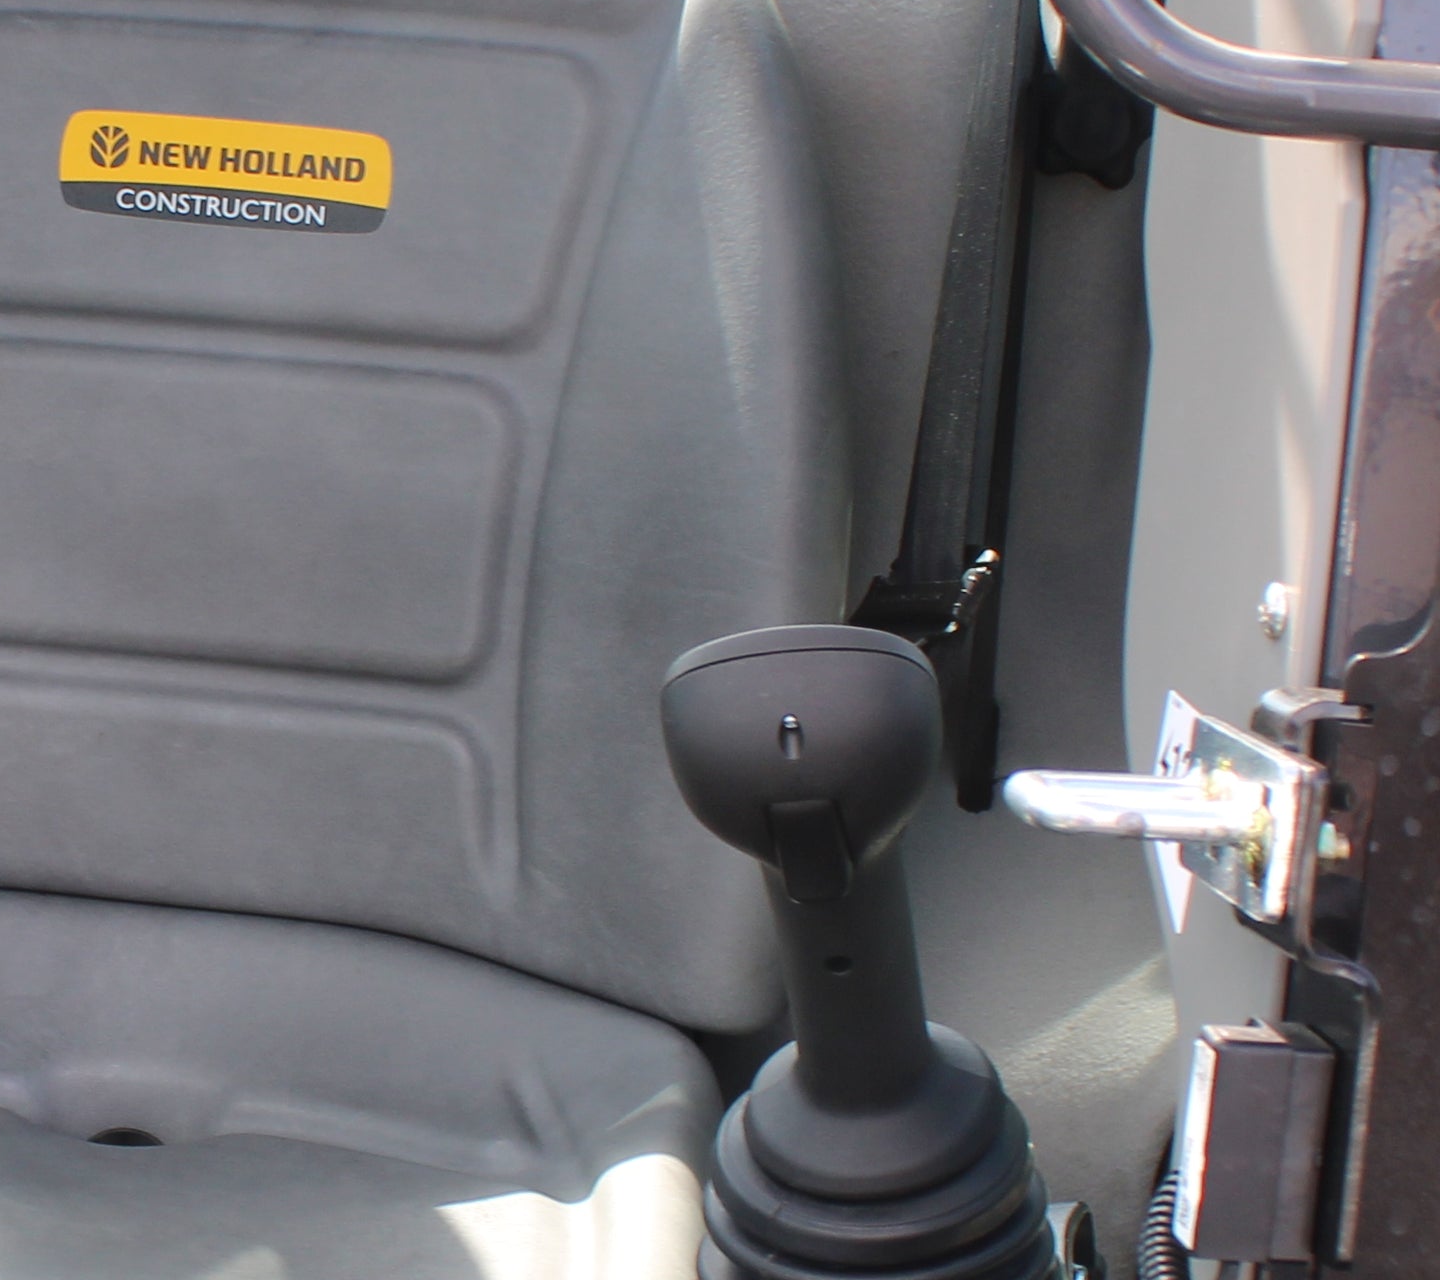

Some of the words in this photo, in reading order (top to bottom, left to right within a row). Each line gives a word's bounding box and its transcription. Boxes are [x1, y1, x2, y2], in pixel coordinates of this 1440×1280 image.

[139, 140, 212, 171] NEW
[219, 147, 366, 183] HOLLAND
[115, 187, 326, 227] CONSTRUCTION
